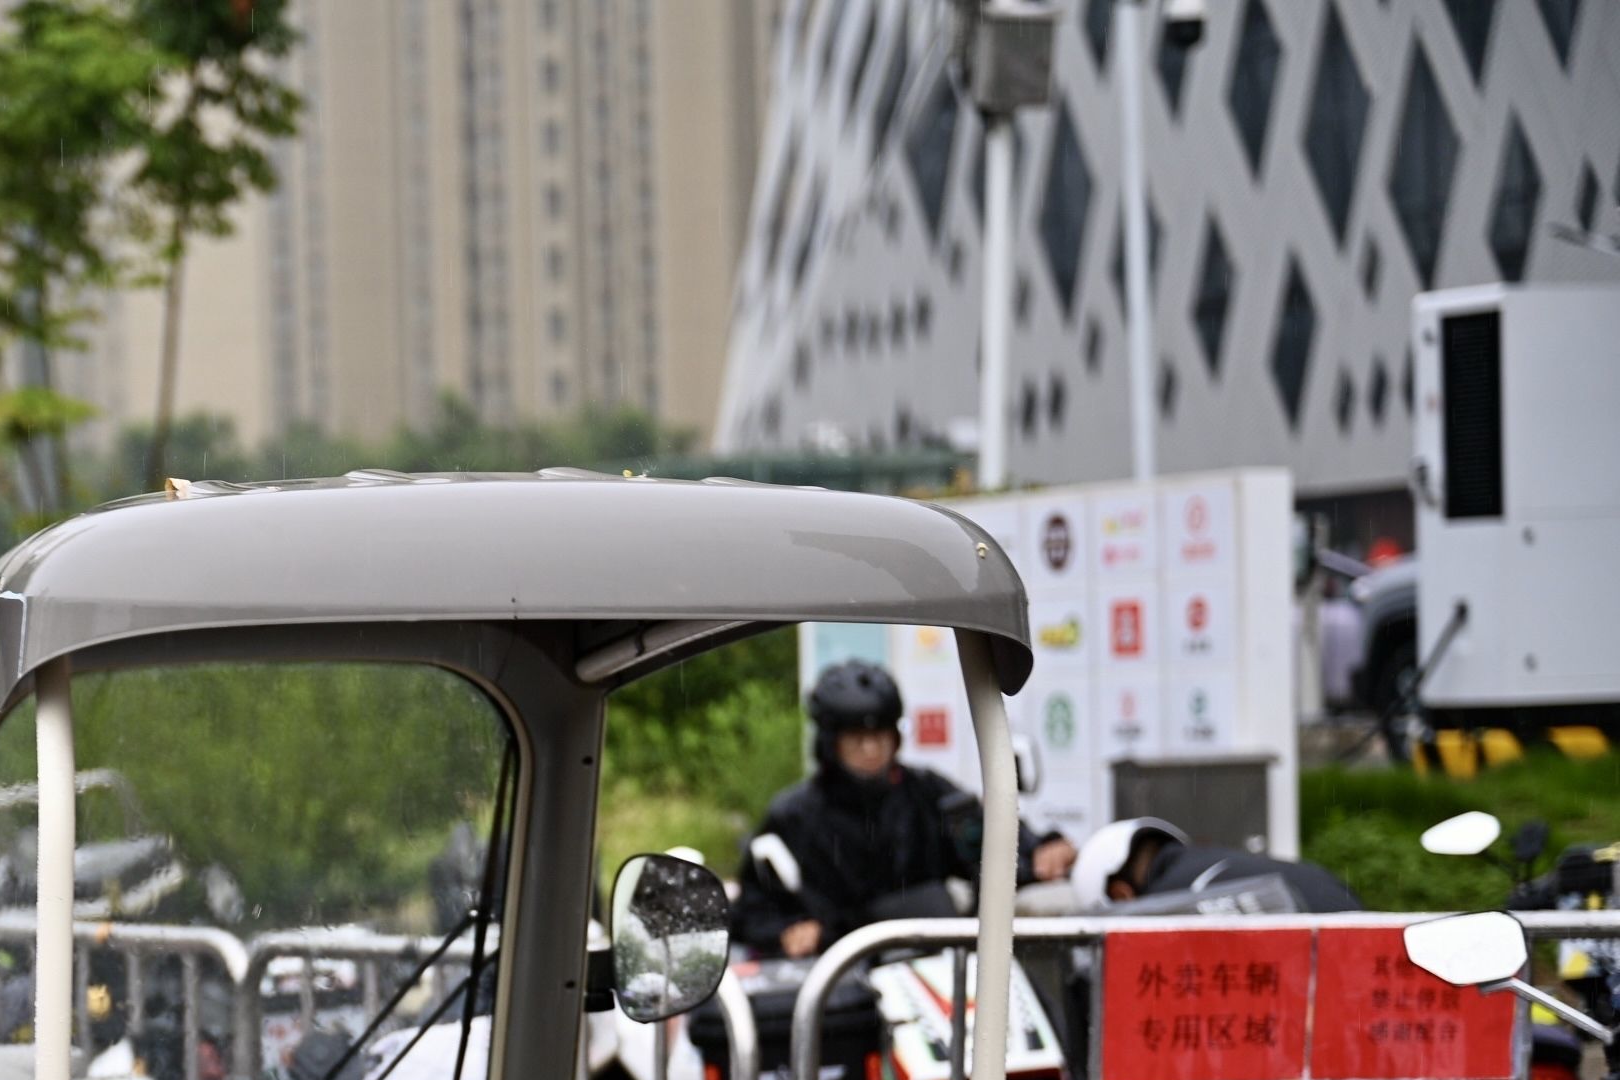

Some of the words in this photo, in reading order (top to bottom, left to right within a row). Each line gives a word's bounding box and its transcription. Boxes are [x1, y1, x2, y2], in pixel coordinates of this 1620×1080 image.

[1136, 961, 1281, 998] 外卖车辆
[1134, 1014, 1278, 1052] 专用区域
